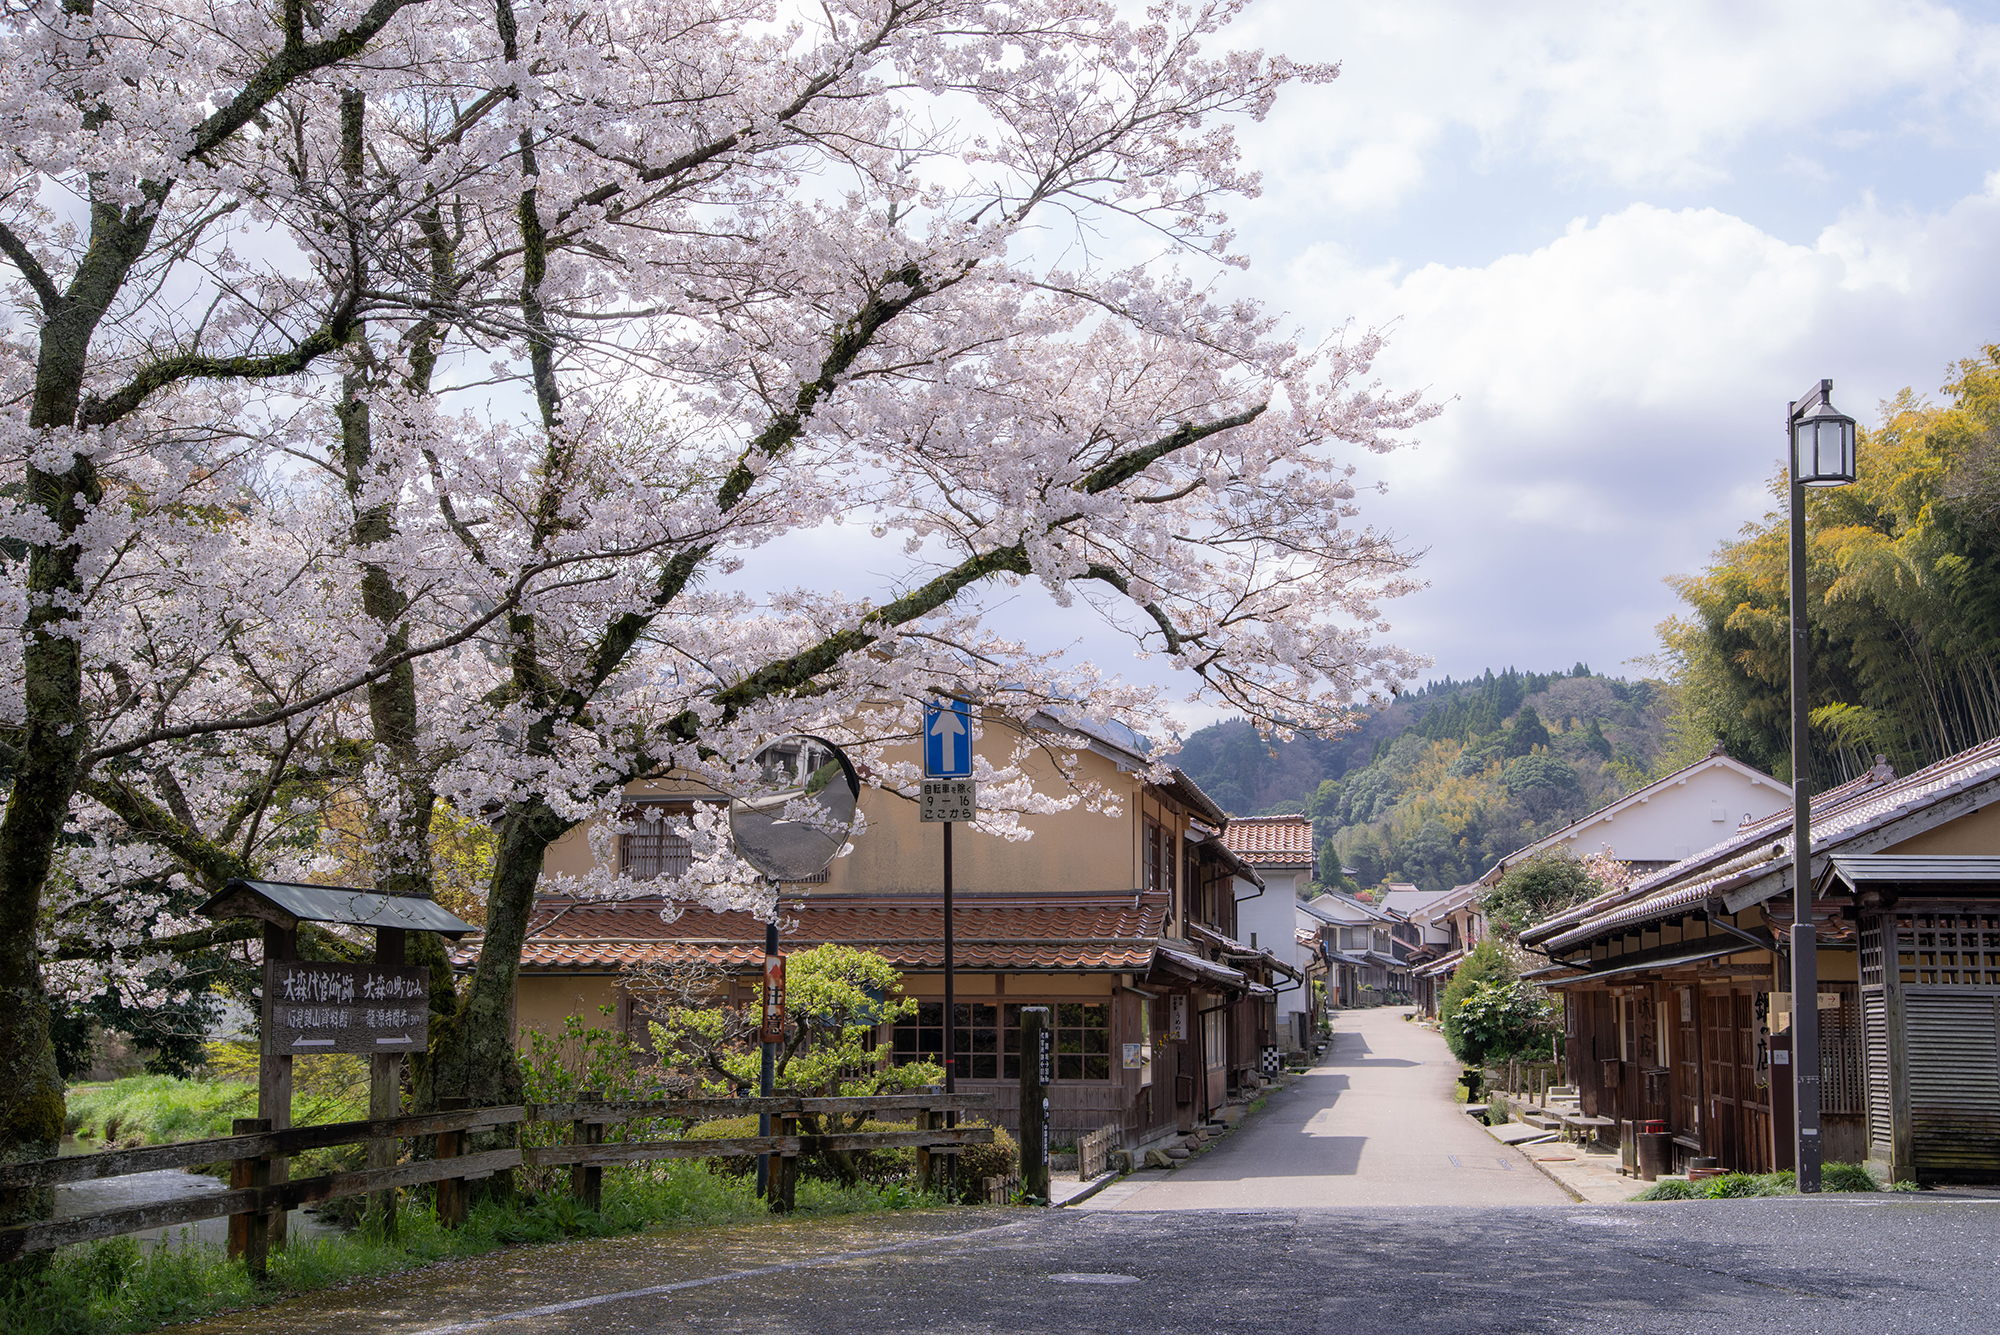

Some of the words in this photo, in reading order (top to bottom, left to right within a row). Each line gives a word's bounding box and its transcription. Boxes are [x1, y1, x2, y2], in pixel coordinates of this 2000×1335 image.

[924, 783, 972, 795] 自転車を除く
[927, 796, 934, 807] 9
[959, 795, 970, 806] 16
[924, 808, 972, 819] ここから
[282, 968, 355, 1004] 大森代官所跡
[363, 972, 424, 1001] 大森の町なみ
[765, 985, 783, 1035] 注意
[1637, 995, 1652, 1058] 味の店
[1754, 991, 1770, 1072] 銀の店
